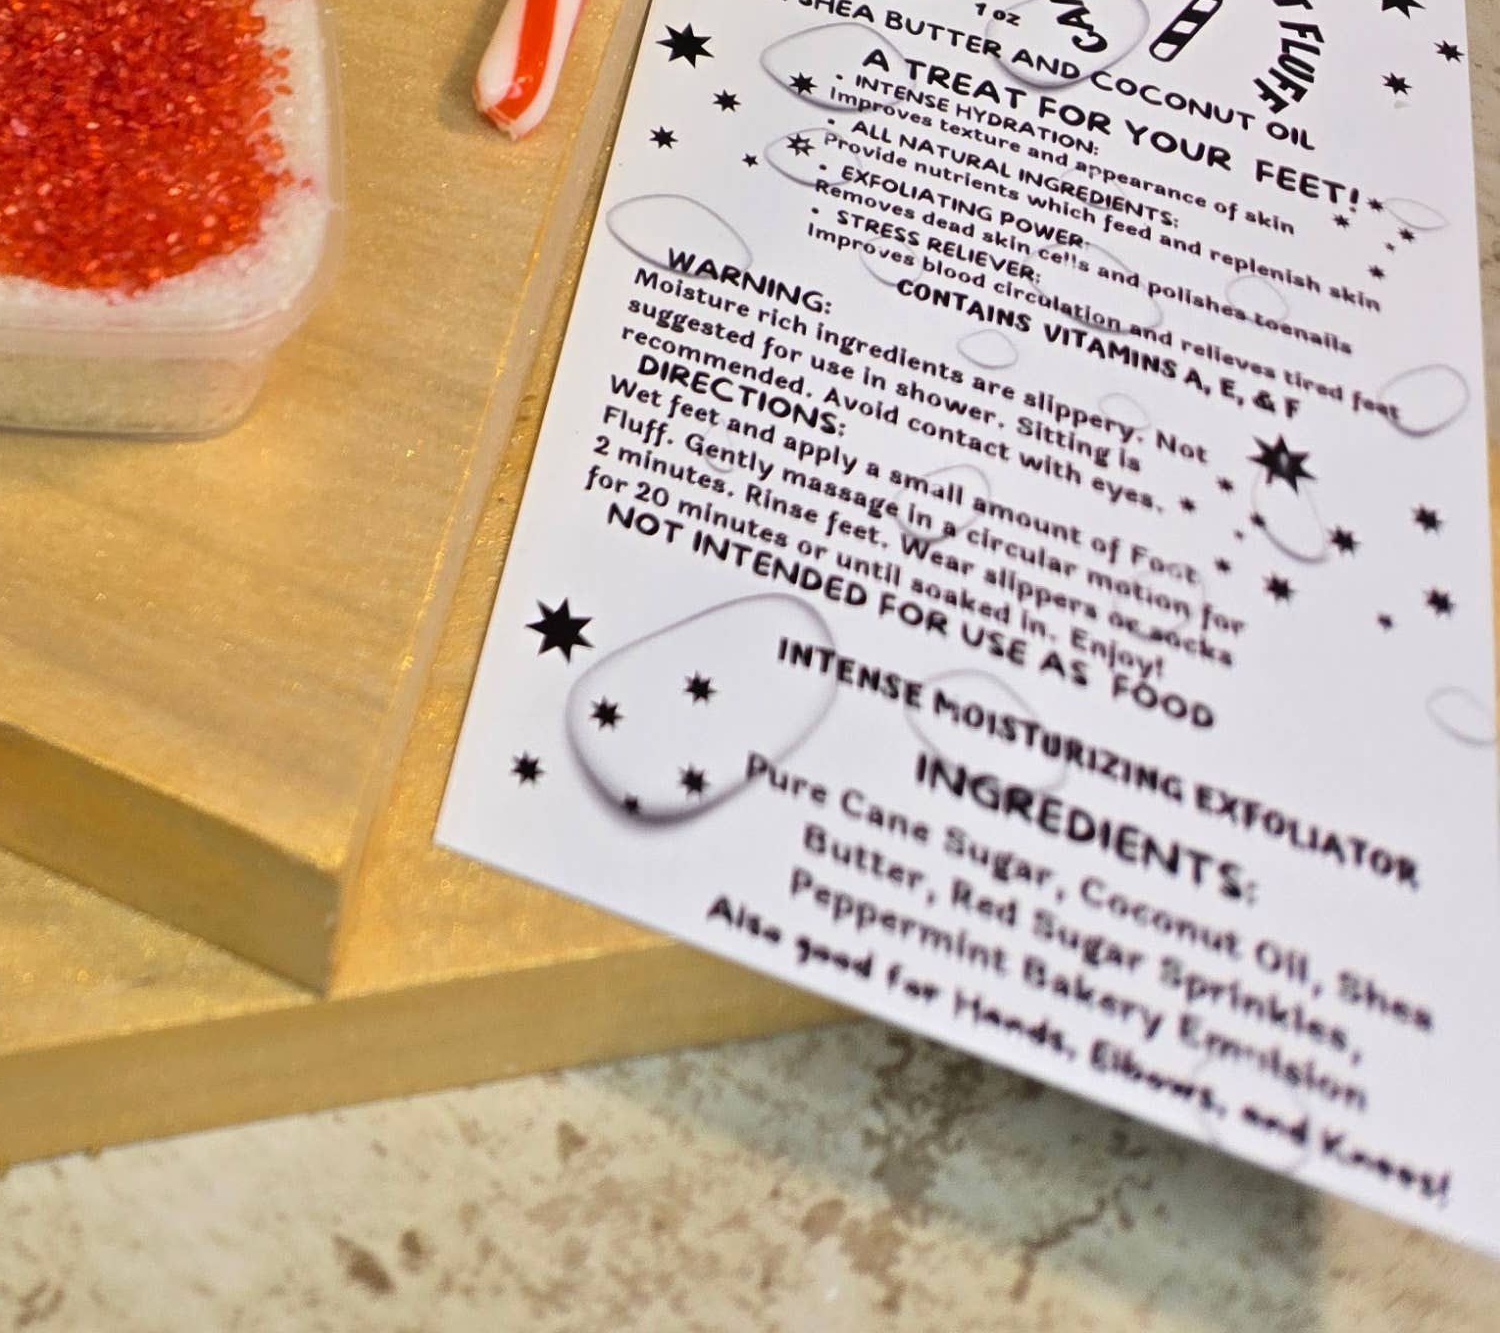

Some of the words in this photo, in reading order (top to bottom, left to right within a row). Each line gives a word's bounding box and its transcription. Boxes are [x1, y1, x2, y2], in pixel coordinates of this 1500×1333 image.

[883, 8, 1004, 67] BUTTER
[1010, 47, 1081, 87] AND
[1086, 69, 1256, 132] COCONUT
[1265, 120, 1316, 152] OIL
[975, 3, 987, 16] 1
[993, 10, 1021, 26] oz
[1252, 20, 1325, 114] FLUFF
[829, 85, 933, 128] Improves
[939, 117, 1022, 154] texture
[1026, 146, 1069, 168] and
[1073, 160, 1207, 209] appearance
[1212, 201, 1239, 222] of
[1243, 209, 1295, 236] skin
[840, 164, 993, 223] EXFOLIATING
[849, 119, 892, 145] ALL
[898, 132, 1012, 179] NATURAL
[1017, 167, 1179, 229] INGREDIENTS:
[854, 73, 951, 113] INTENSE
[954, 102, 1100, 157] HYDRATION:
[860, 47, 891, 73] A
[902, 57, 1028, 110] TREAT
[1037, 94, 1112, 137] FOR
[1123, 118, 1232, 172] YOUR
[1254, 158, 1360, 213] FEET!
[661, 246, 833, 316] WARNING:
[811, 177, 916, 221] Removes
[920, 210, 976, 239] dead
[980, 230, 1031, 257] skin
[1096, 265, 1140, 289] and
[1146, 280, 1249, 322] polishes
[1251, 311, 1353, 356] toenails
[823, 131, 908, 168] Provide
[913, 160, 1020, 202] nutrients
[1026, 193, 1096, 225] which
[1102, 212, 1152, 242] feed
[1158, 233, 1202, 257] and
[1209, 248, 1321, 294] replenish
[1328, 285, 1381, 313] skin
[836, 208, 921, 247] STRESS
[925, 235, 1041, 285] RELIEVER:
[626, 298, 756, 350] suggested
[760, 335, 804, 364] for
[809, 354, 855, 381] use
[861, 365, 887, 392] in
[894, 379, 1005, 429] shower.
[1015, 415, 1112, 470] Sitting
[1118, 446, 1141, 474] is
[633, 266, 750, 318] Moisture
[756, 307, 808, 337] rich
[815, 321, 964, 385] ingredients
[970, 375, 1016, 401] are
[1022, 390, 1144, 445] slippery.
[1155, 428, 1208, 465] Not
[636, 353, 847, 438] DIRECTIONS:
[806, 221, 916, 267] Improves
[921, 254, 986, 289] blood
[992, 280, 1124, 334] circulation
[1126, 323, 1173, 348] and
[1180, 338, 1277, 381] relieves
[1283, 369, 1344, 403] tired
[894, 277, 1033, 333] CONTAINS
[1042, 322, 1178, 380] VITAMINS
[1182, 366, 1212, 397] A,
[1218, 376, 1245, 408] E,
[1251, 388, 1277, 415] &
[1283, 396, 1301, 420] F
[609, 373, 663, 409] Wet
[665, 393, 721, 427] feet
[725, 416, 776, 445] and
[781, 435, 858, 476] apply
[864, 461, 880, 480] a
[888, 468, 964, 507] small
[971, 496, 1082, 546] amount
[1089, 536, 1121, 566] of
[620, 325, 813, 399] recommended.
[821, 385, 900, 426] Avoid
[906, 416, 1011, 462] contact
[1018, 451, 1082, 486] with
[583, 463, 629, 494] for
[633, 480, 670, 508] 20
[676, 498, 789, 549] minutes
[795, 538, 829, 561] or
[835, 551, 902, 588] until
[909, 577, 1011, 626] soaked
[1069, 626, 1164, 682] Enjoy!
[592, 434, 611, 457] 2
[616, 446, 735, 498] minutes.
[744, 482, 819, 525] Rinse
[824, 509, 888, 550] feet.
[899, 529, 976, 577] Wear
[982, 566, 1098, 621] slippers
[601, 404, 674, 448] Fluff.
[683, 432, 775, 483] Gently
[780, 466, 900, 520] massage
[906, 502, 933, 531] in
[941, 520, 959, 539] a
[965, 526, 1078, 578] circular
[1086, 569, 1191, 621] motion
[1200, 602, 1245, 636] for
[606, 501, 685, 544] NOT
[691, 528, 868, 607] INTENDED
[877, 590, 949, 638] FOR
[959, 621, 1028, 668] USE
[1038, 649, 1089, 688] AS
[1110, 673, 1215, 730] FOOD
[776, 635, 926, 712] INTENSE
[931, 687, 1185, 806] MOISTURIZING
[1193, 782, 1420, 891] EXFOLIATOR
[743, 750, 829, 807] Pure
[838, 787, 931, 846] Cane
[943, 825, 1066, 904] Sugar,
[1078, 875, 1240, 961] Coconut
[1253, 939, 1323, 999] Oil,
[1337, 970, 1434, 1033] Shea
[788, 866, 1007, 977] Peppermint
[1021, 954, 1165, 1043] Bakery
[802, 822, 936, 906] Butter,
[949, 876, 1019, 929] Red
[1031, 907, 1146, 973] Sugar
[1159, 955, 1362, 1066] Sprinkles,
